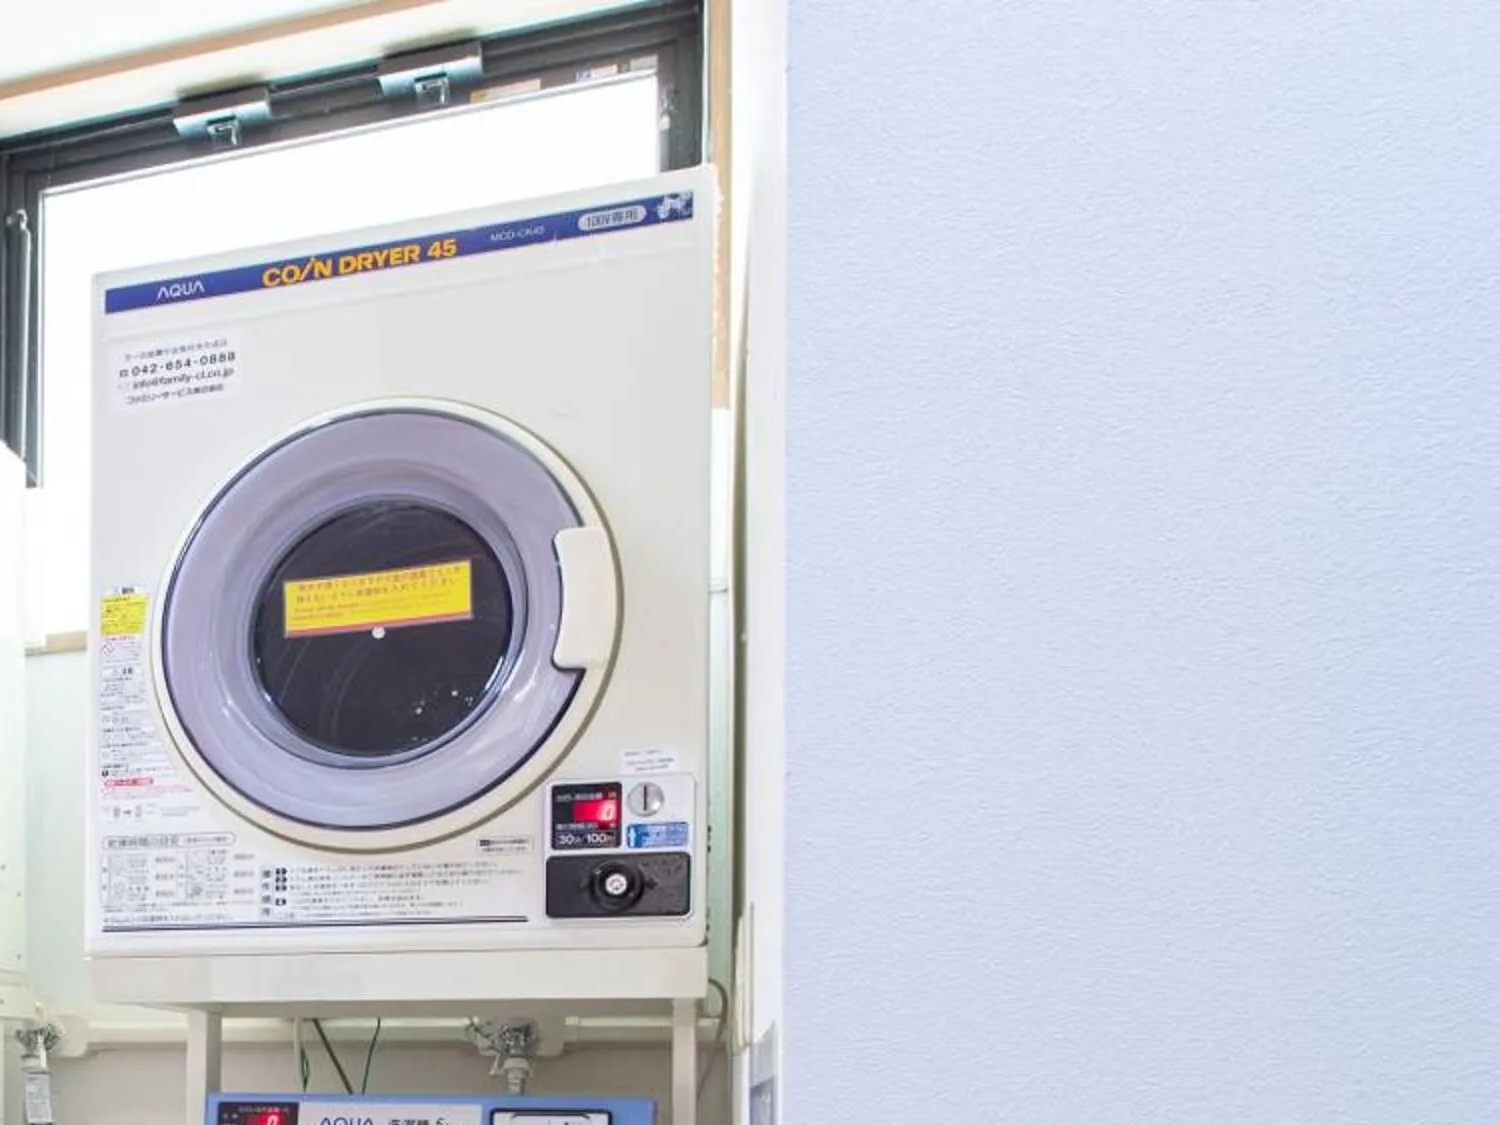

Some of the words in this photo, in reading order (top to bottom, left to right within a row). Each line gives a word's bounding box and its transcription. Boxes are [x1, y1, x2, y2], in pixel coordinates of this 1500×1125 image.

[339, 245, 421, 274] DRYER
[427, 238, 457, 259] 45
[157, 281, 205, 300] AQUA
